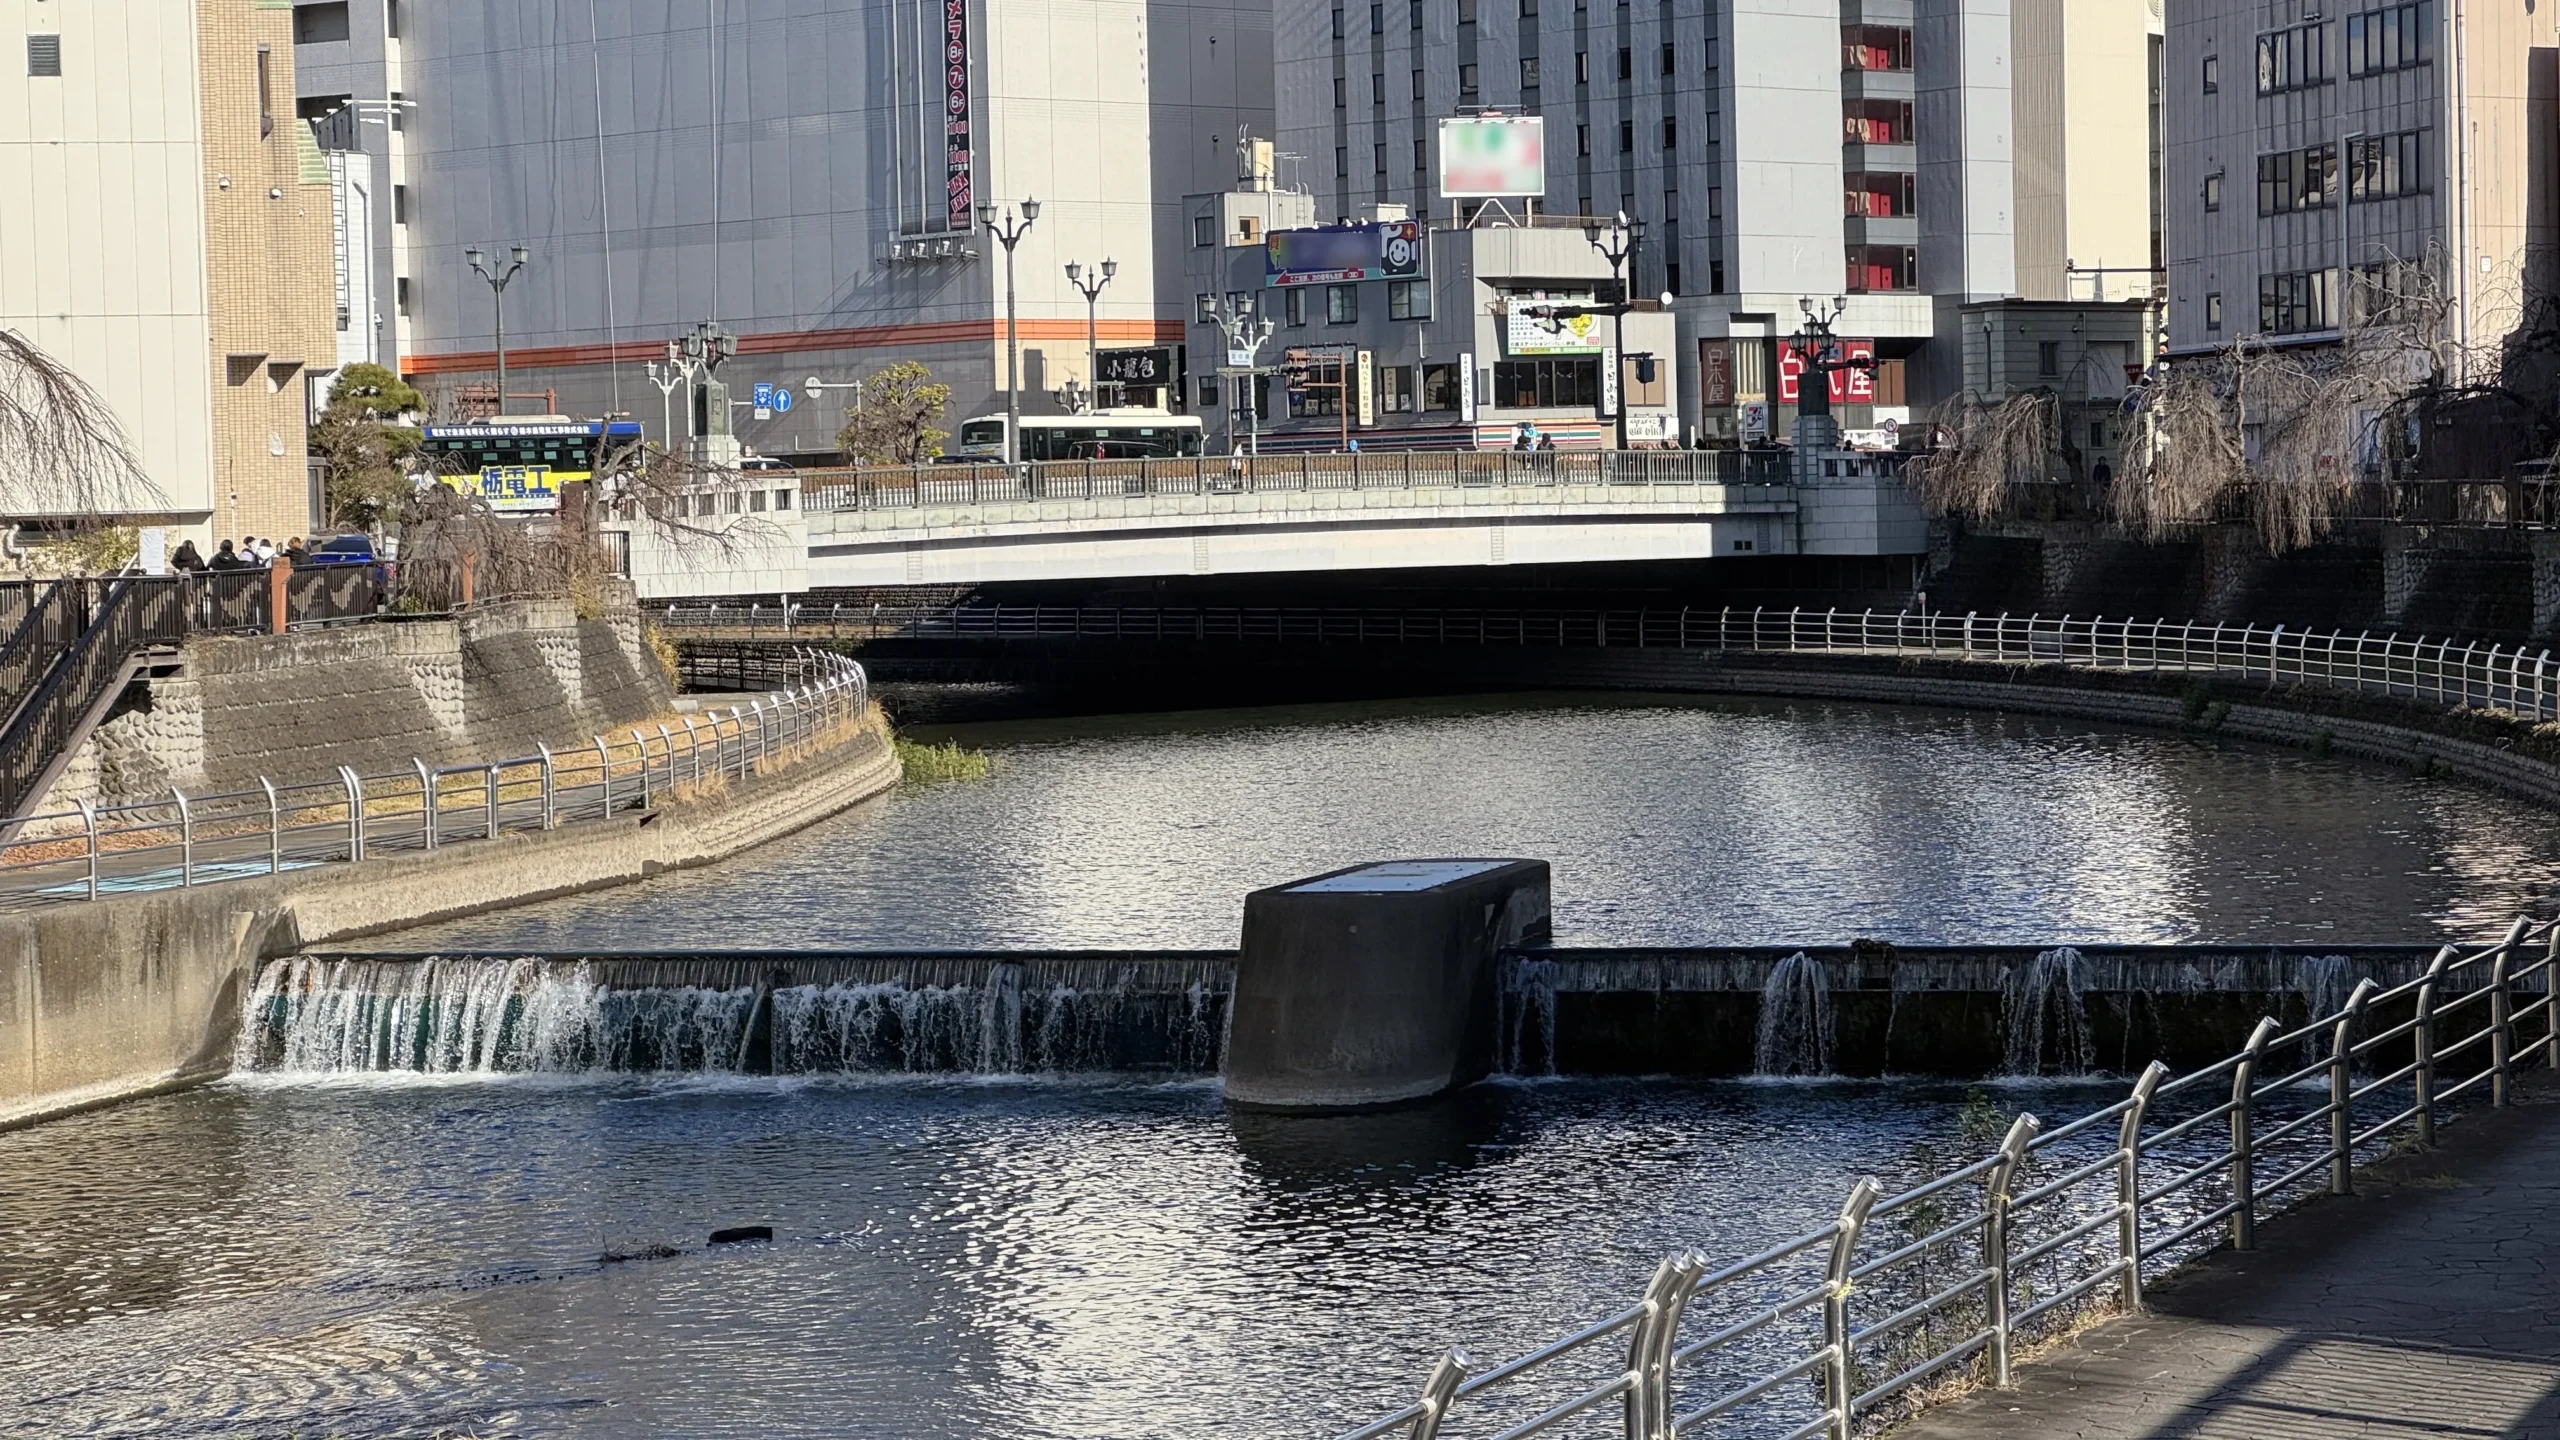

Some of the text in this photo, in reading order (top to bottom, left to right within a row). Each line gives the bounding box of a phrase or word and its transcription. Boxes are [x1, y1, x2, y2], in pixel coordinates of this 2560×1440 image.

[1107, 356, 1155, 378] 小籠包
[1707, 347, 1726, 401] 白木屋
[480, 465, 552, 496] 栃電工
